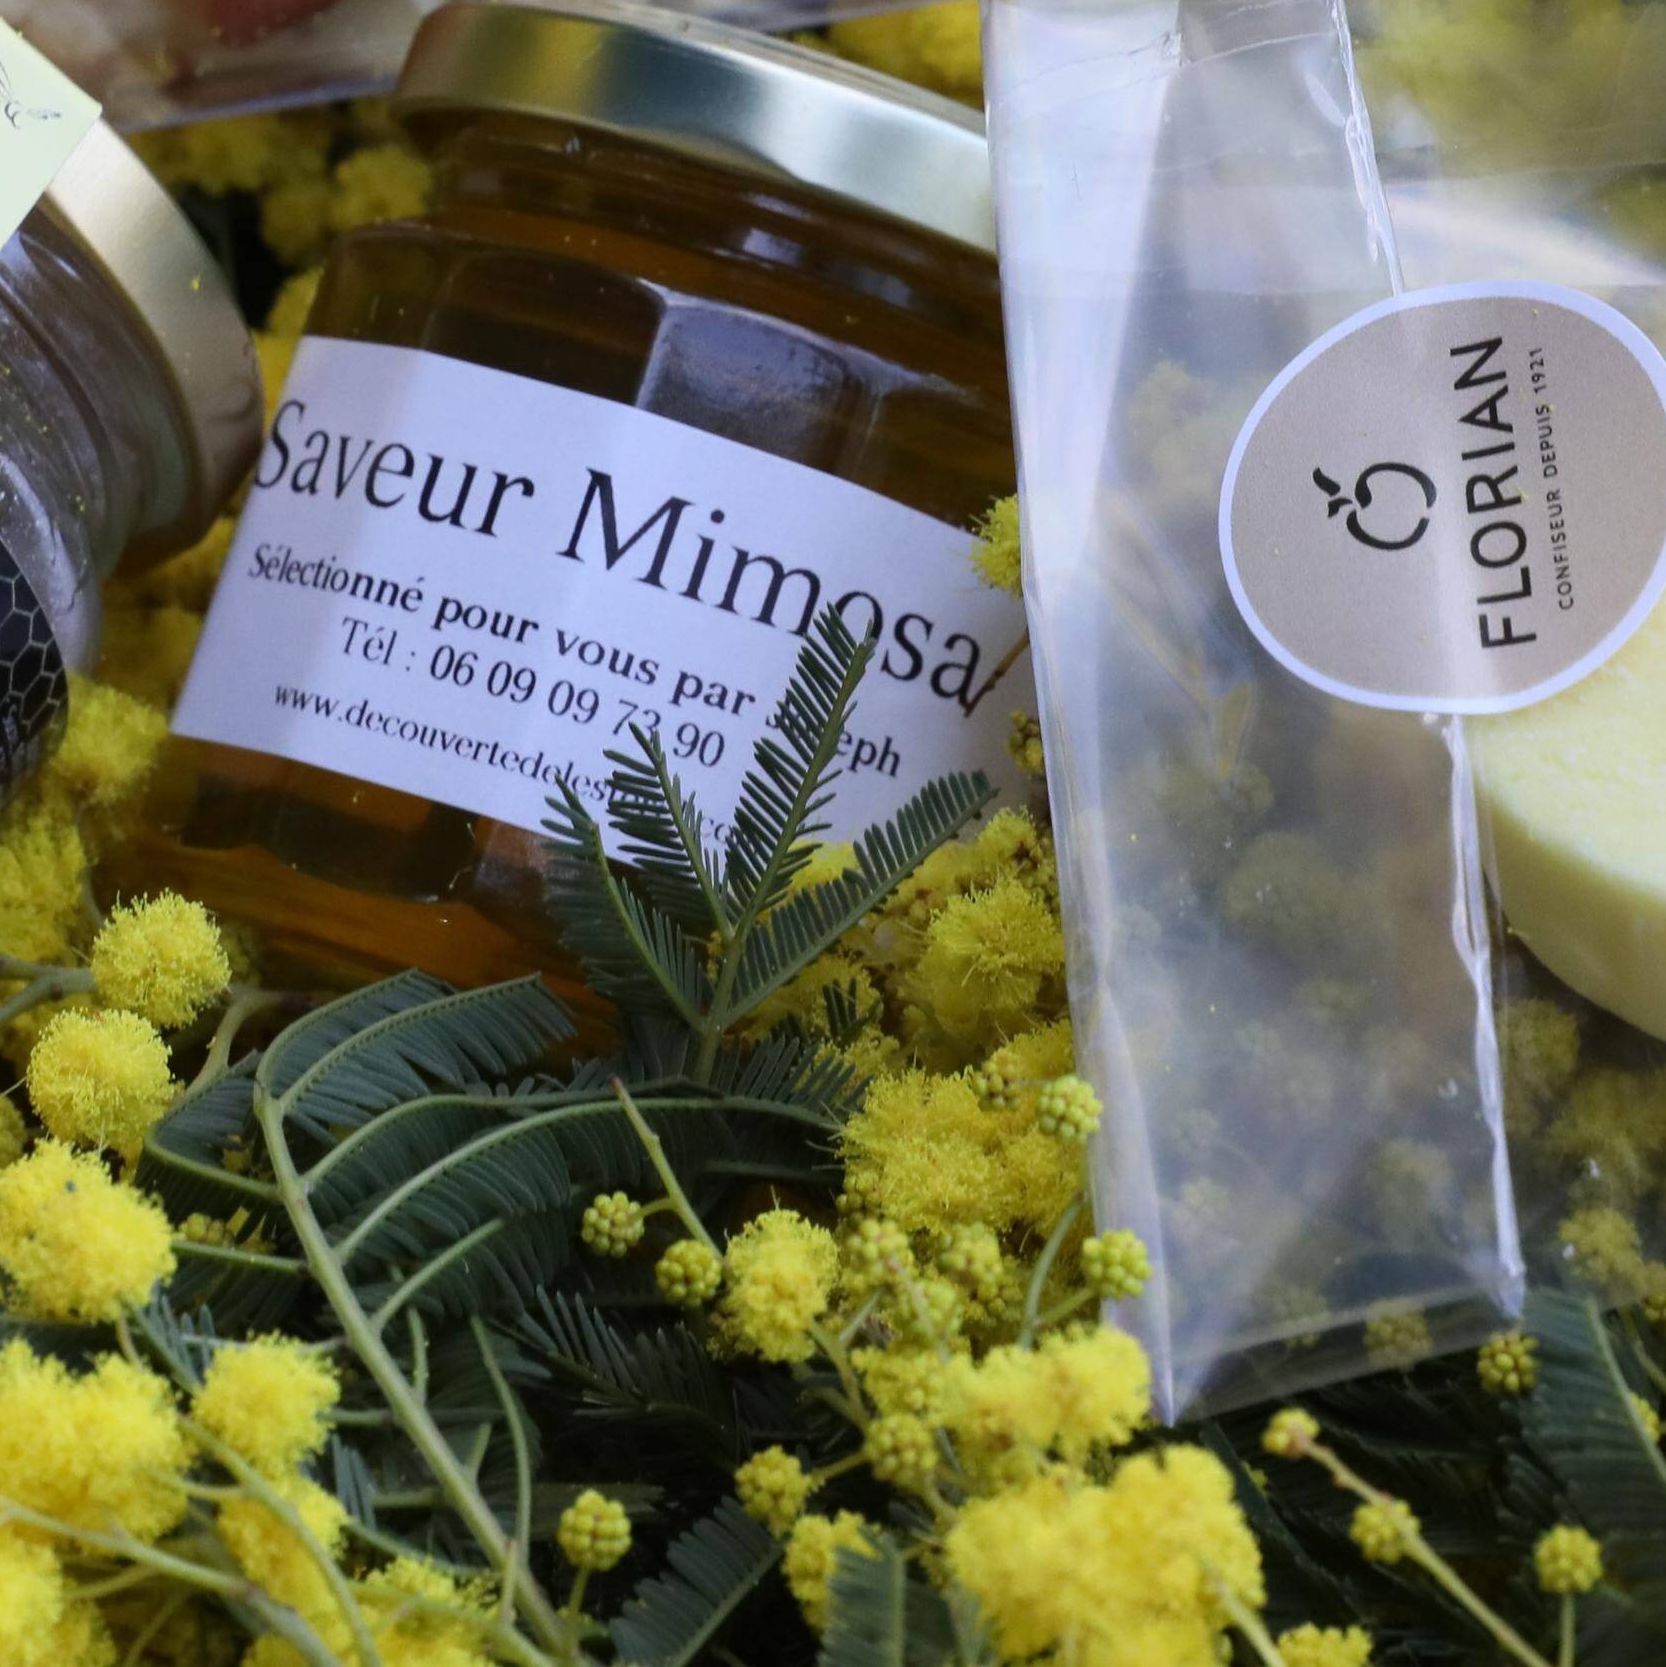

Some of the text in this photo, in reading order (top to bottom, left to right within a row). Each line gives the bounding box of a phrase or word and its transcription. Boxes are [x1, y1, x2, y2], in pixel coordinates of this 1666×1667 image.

[254, 399, 983, 716] Saveur Mimosa
[1449, 336, 1538, 649] FLORIAN
[1528, 346, 1575, 612] CONFISEUR DEPUIS 1921
[247, 541, 901, 779] Sélectionné pour vous par eph
[341, 615, 398, 667] Tél
[429, 644, 480, 687] 06
[486, 660, 537, 704] 09
[547, 679, 601, 725] 09
[671, 721, 726, 768] 90
